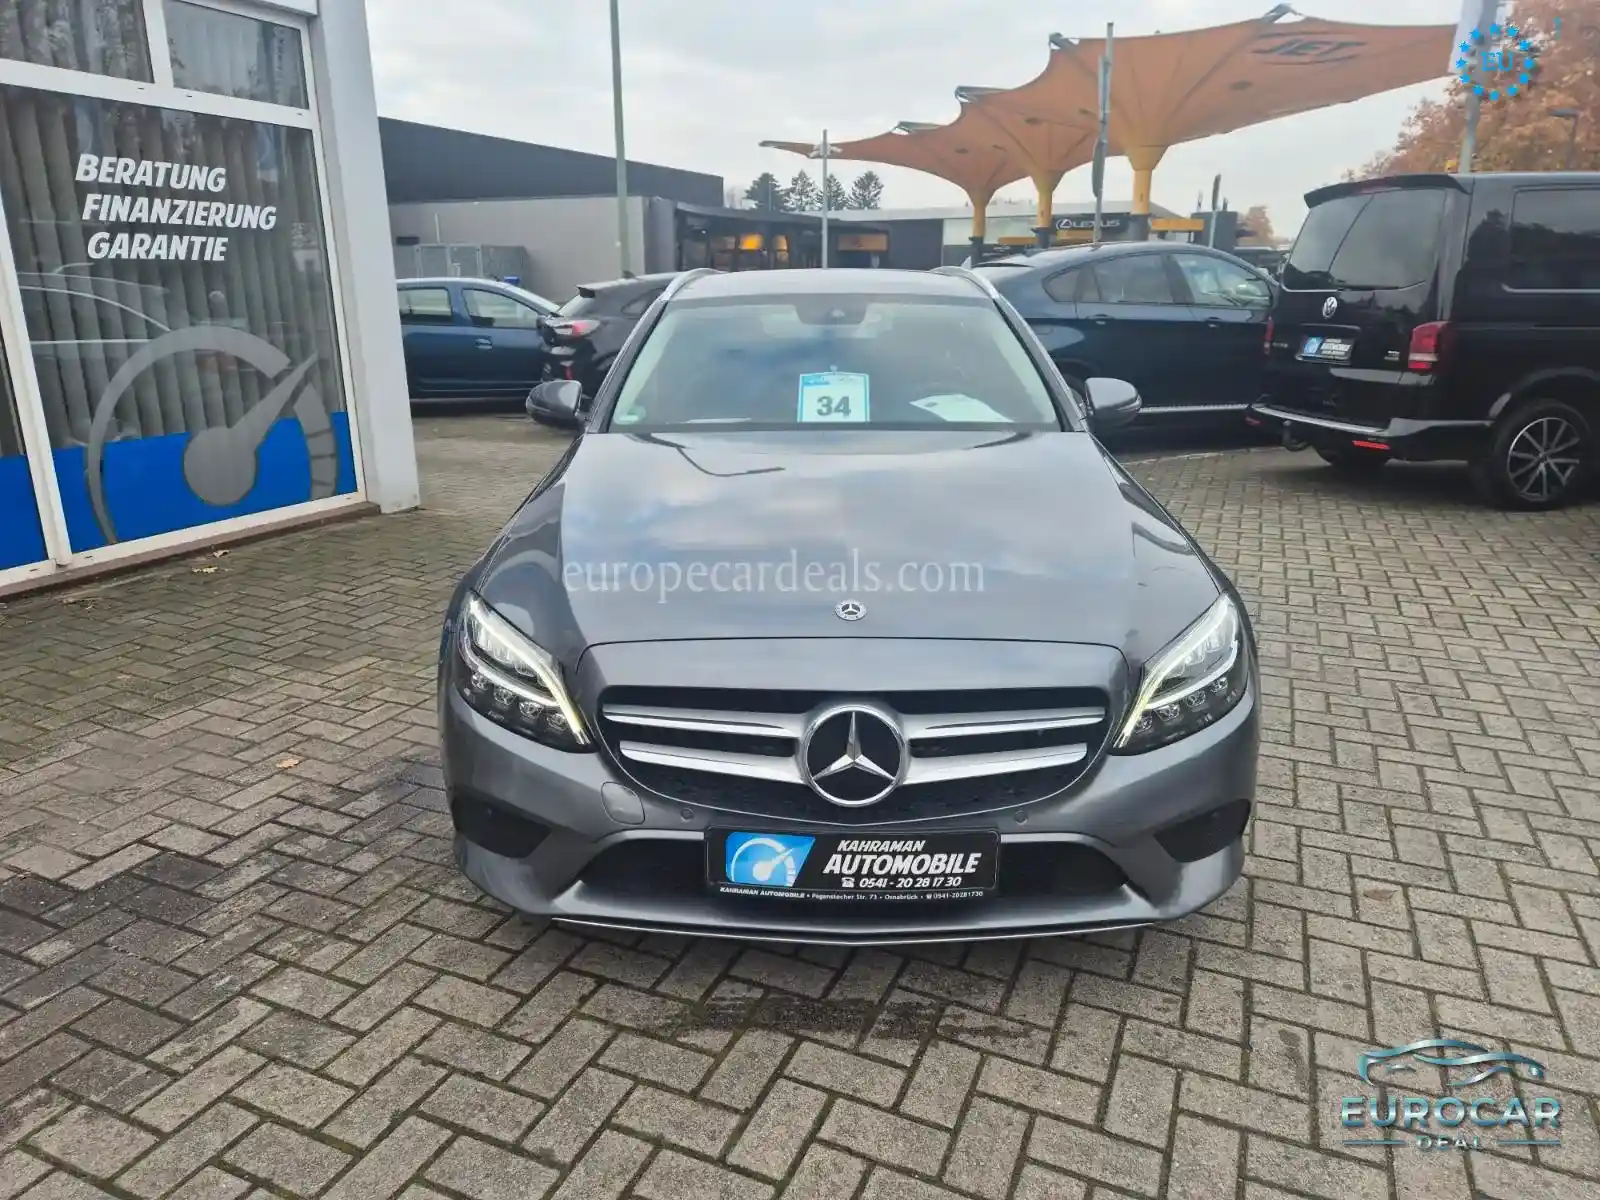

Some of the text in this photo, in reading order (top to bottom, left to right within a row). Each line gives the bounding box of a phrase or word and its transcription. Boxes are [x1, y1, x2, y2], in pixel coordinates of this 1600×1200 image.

[1251, 38, 1367, 55] JET
[75, 153, 226, 193] BERATUNG
[82, 193, 277, 231] FINANZIERUNG
[87, 231, 229, 262] GARANTIE
[816, 396, 851, 417] 34
[837, 839, 926, 852] KAHRAMAN
[822, 853, 982, 875] AUTOMOBILE
[859, 877, 889, 889] 0541
[895, 877, 914, 888] 20
[914, 877, 930, 888] 28
[932, 876, 944, 887] 17
[944, 876, 962, 887] 30
